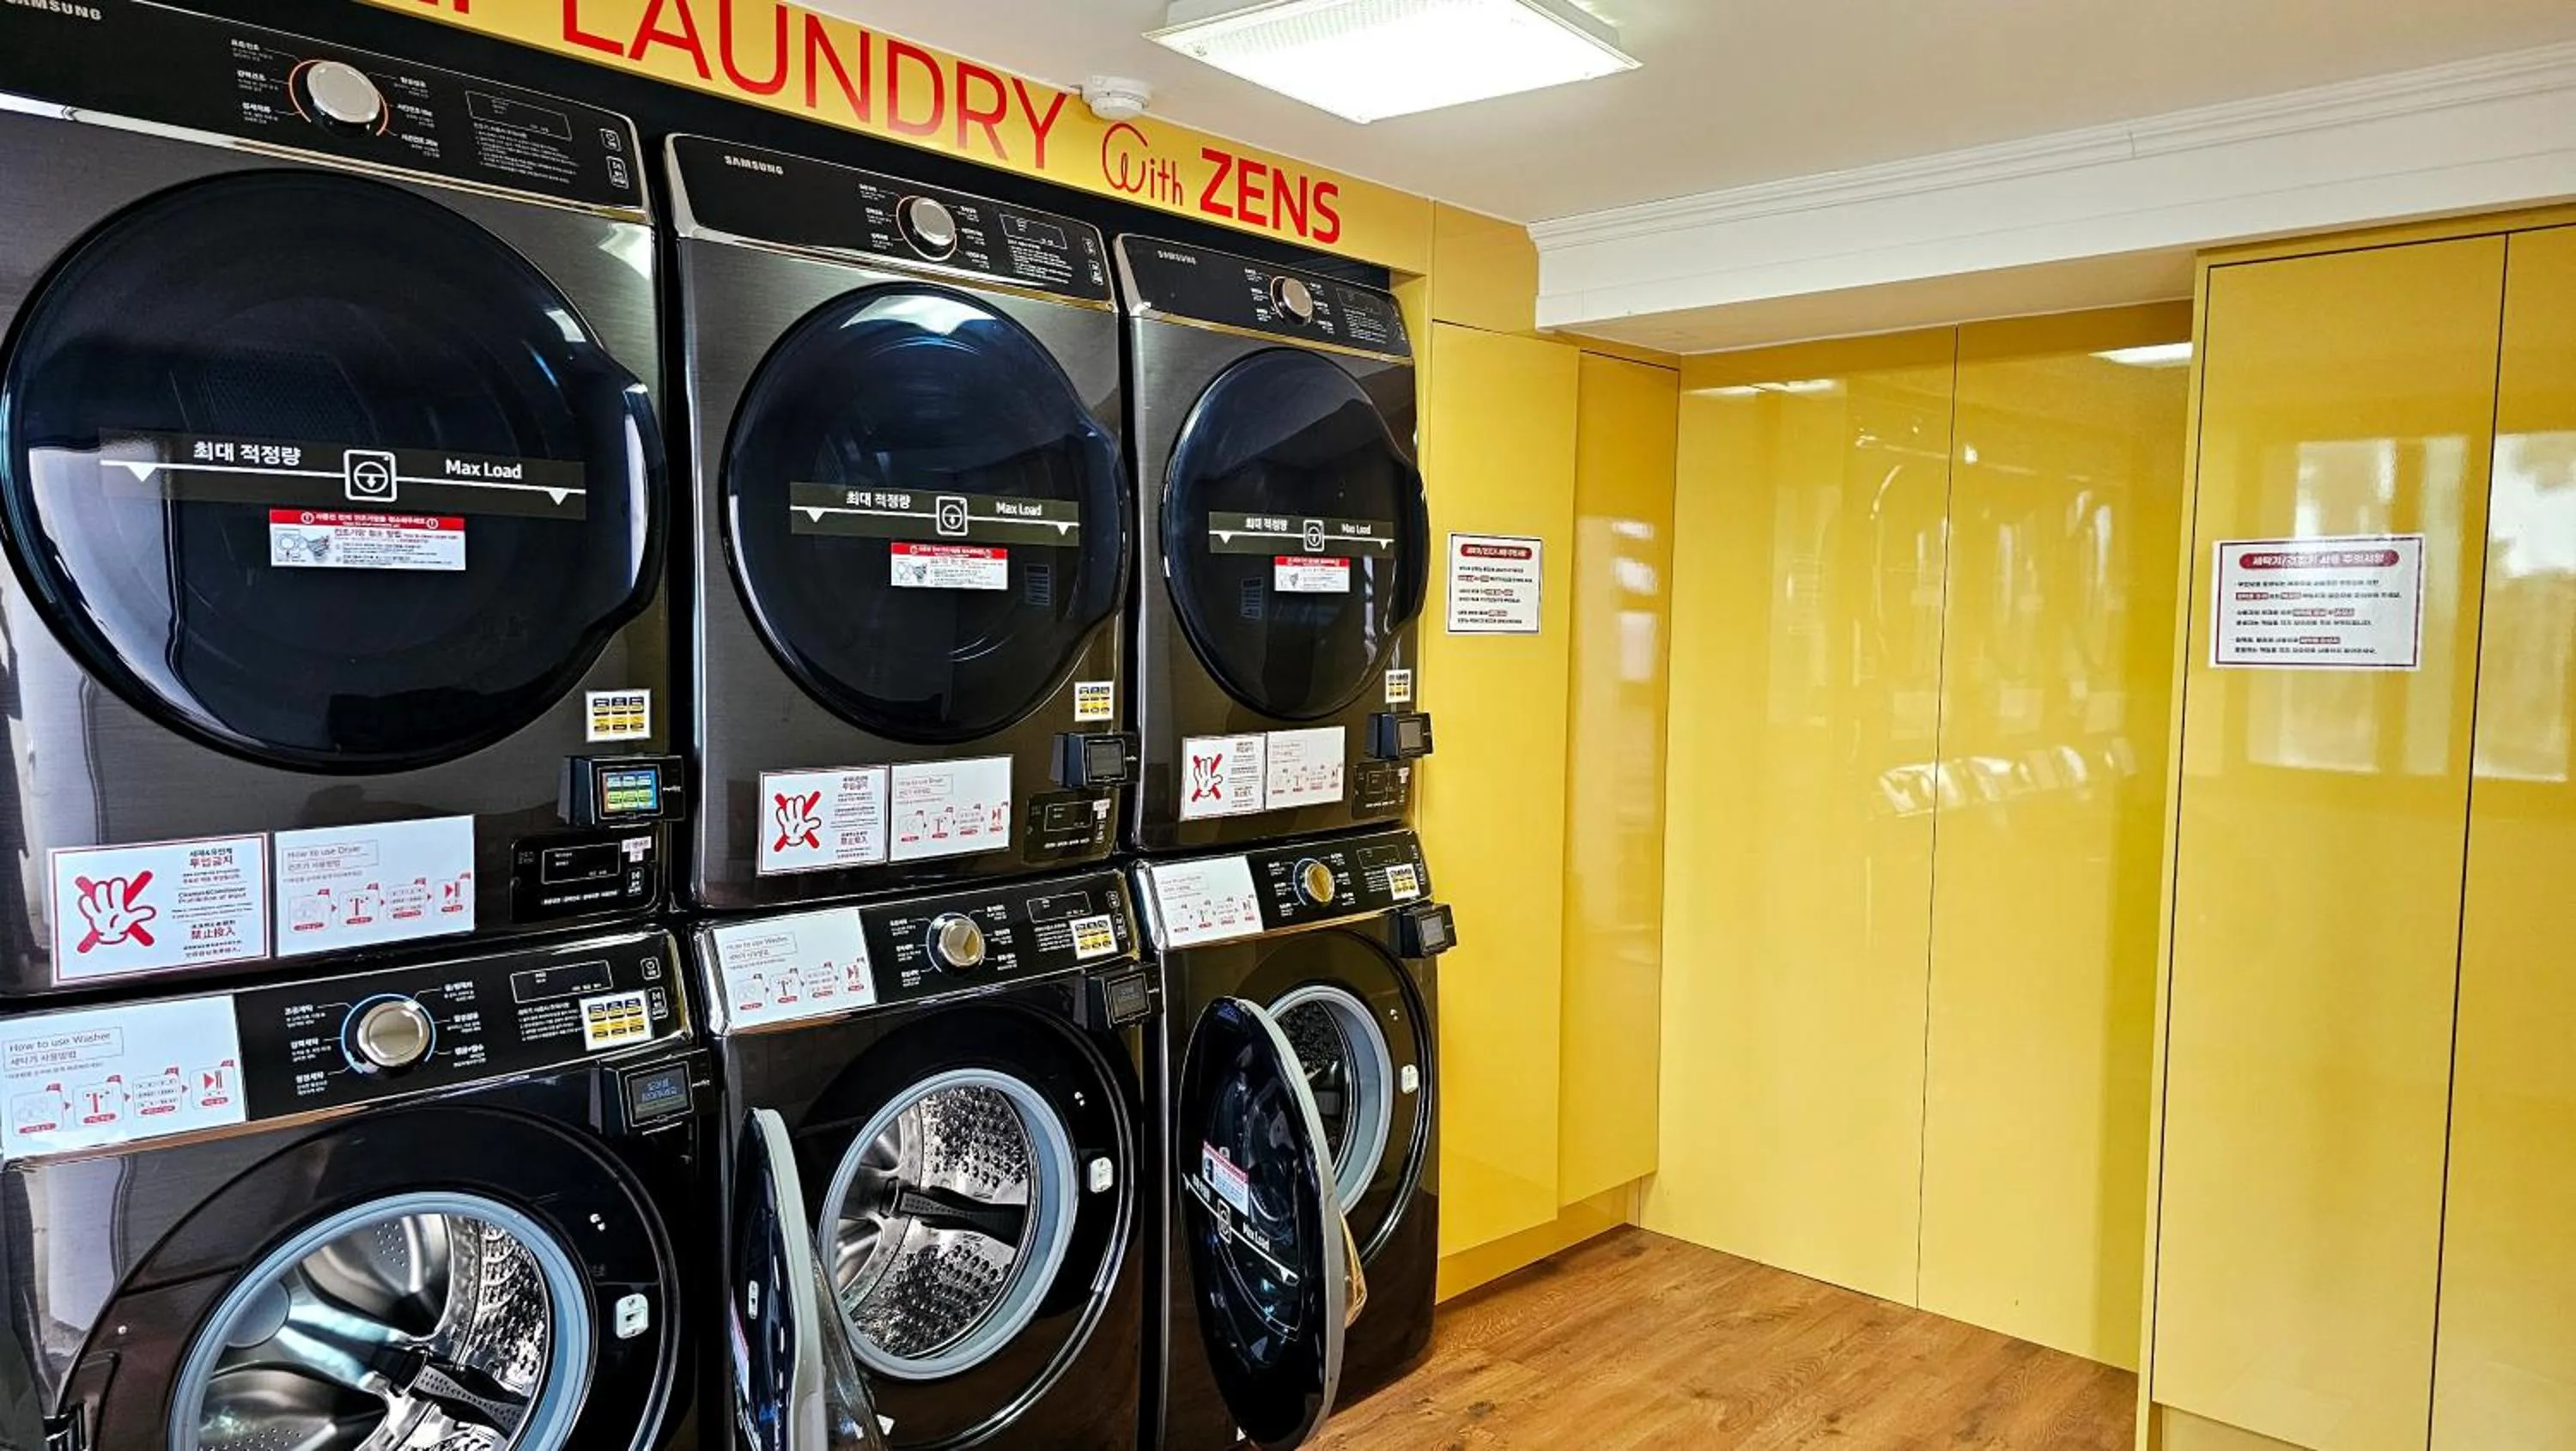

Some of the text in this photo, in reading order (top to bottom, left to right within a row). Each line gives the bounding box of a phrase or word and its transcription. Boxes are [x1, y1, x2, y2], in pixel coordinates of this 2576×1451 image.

[724, 155, 784, 175] SAMSUNG
[1102, 123, 1183, 206] With
[1200, 148, 1341, 245] ZENS
[193, 440, 301, 466] 최대 적정량
[445, 458, 522, 480] Max Load
[846, 490, 872, 507] 최대
[996, 501, 1042, 517] Max Load
[9, 1032, 111, 1052] How to use Washer
